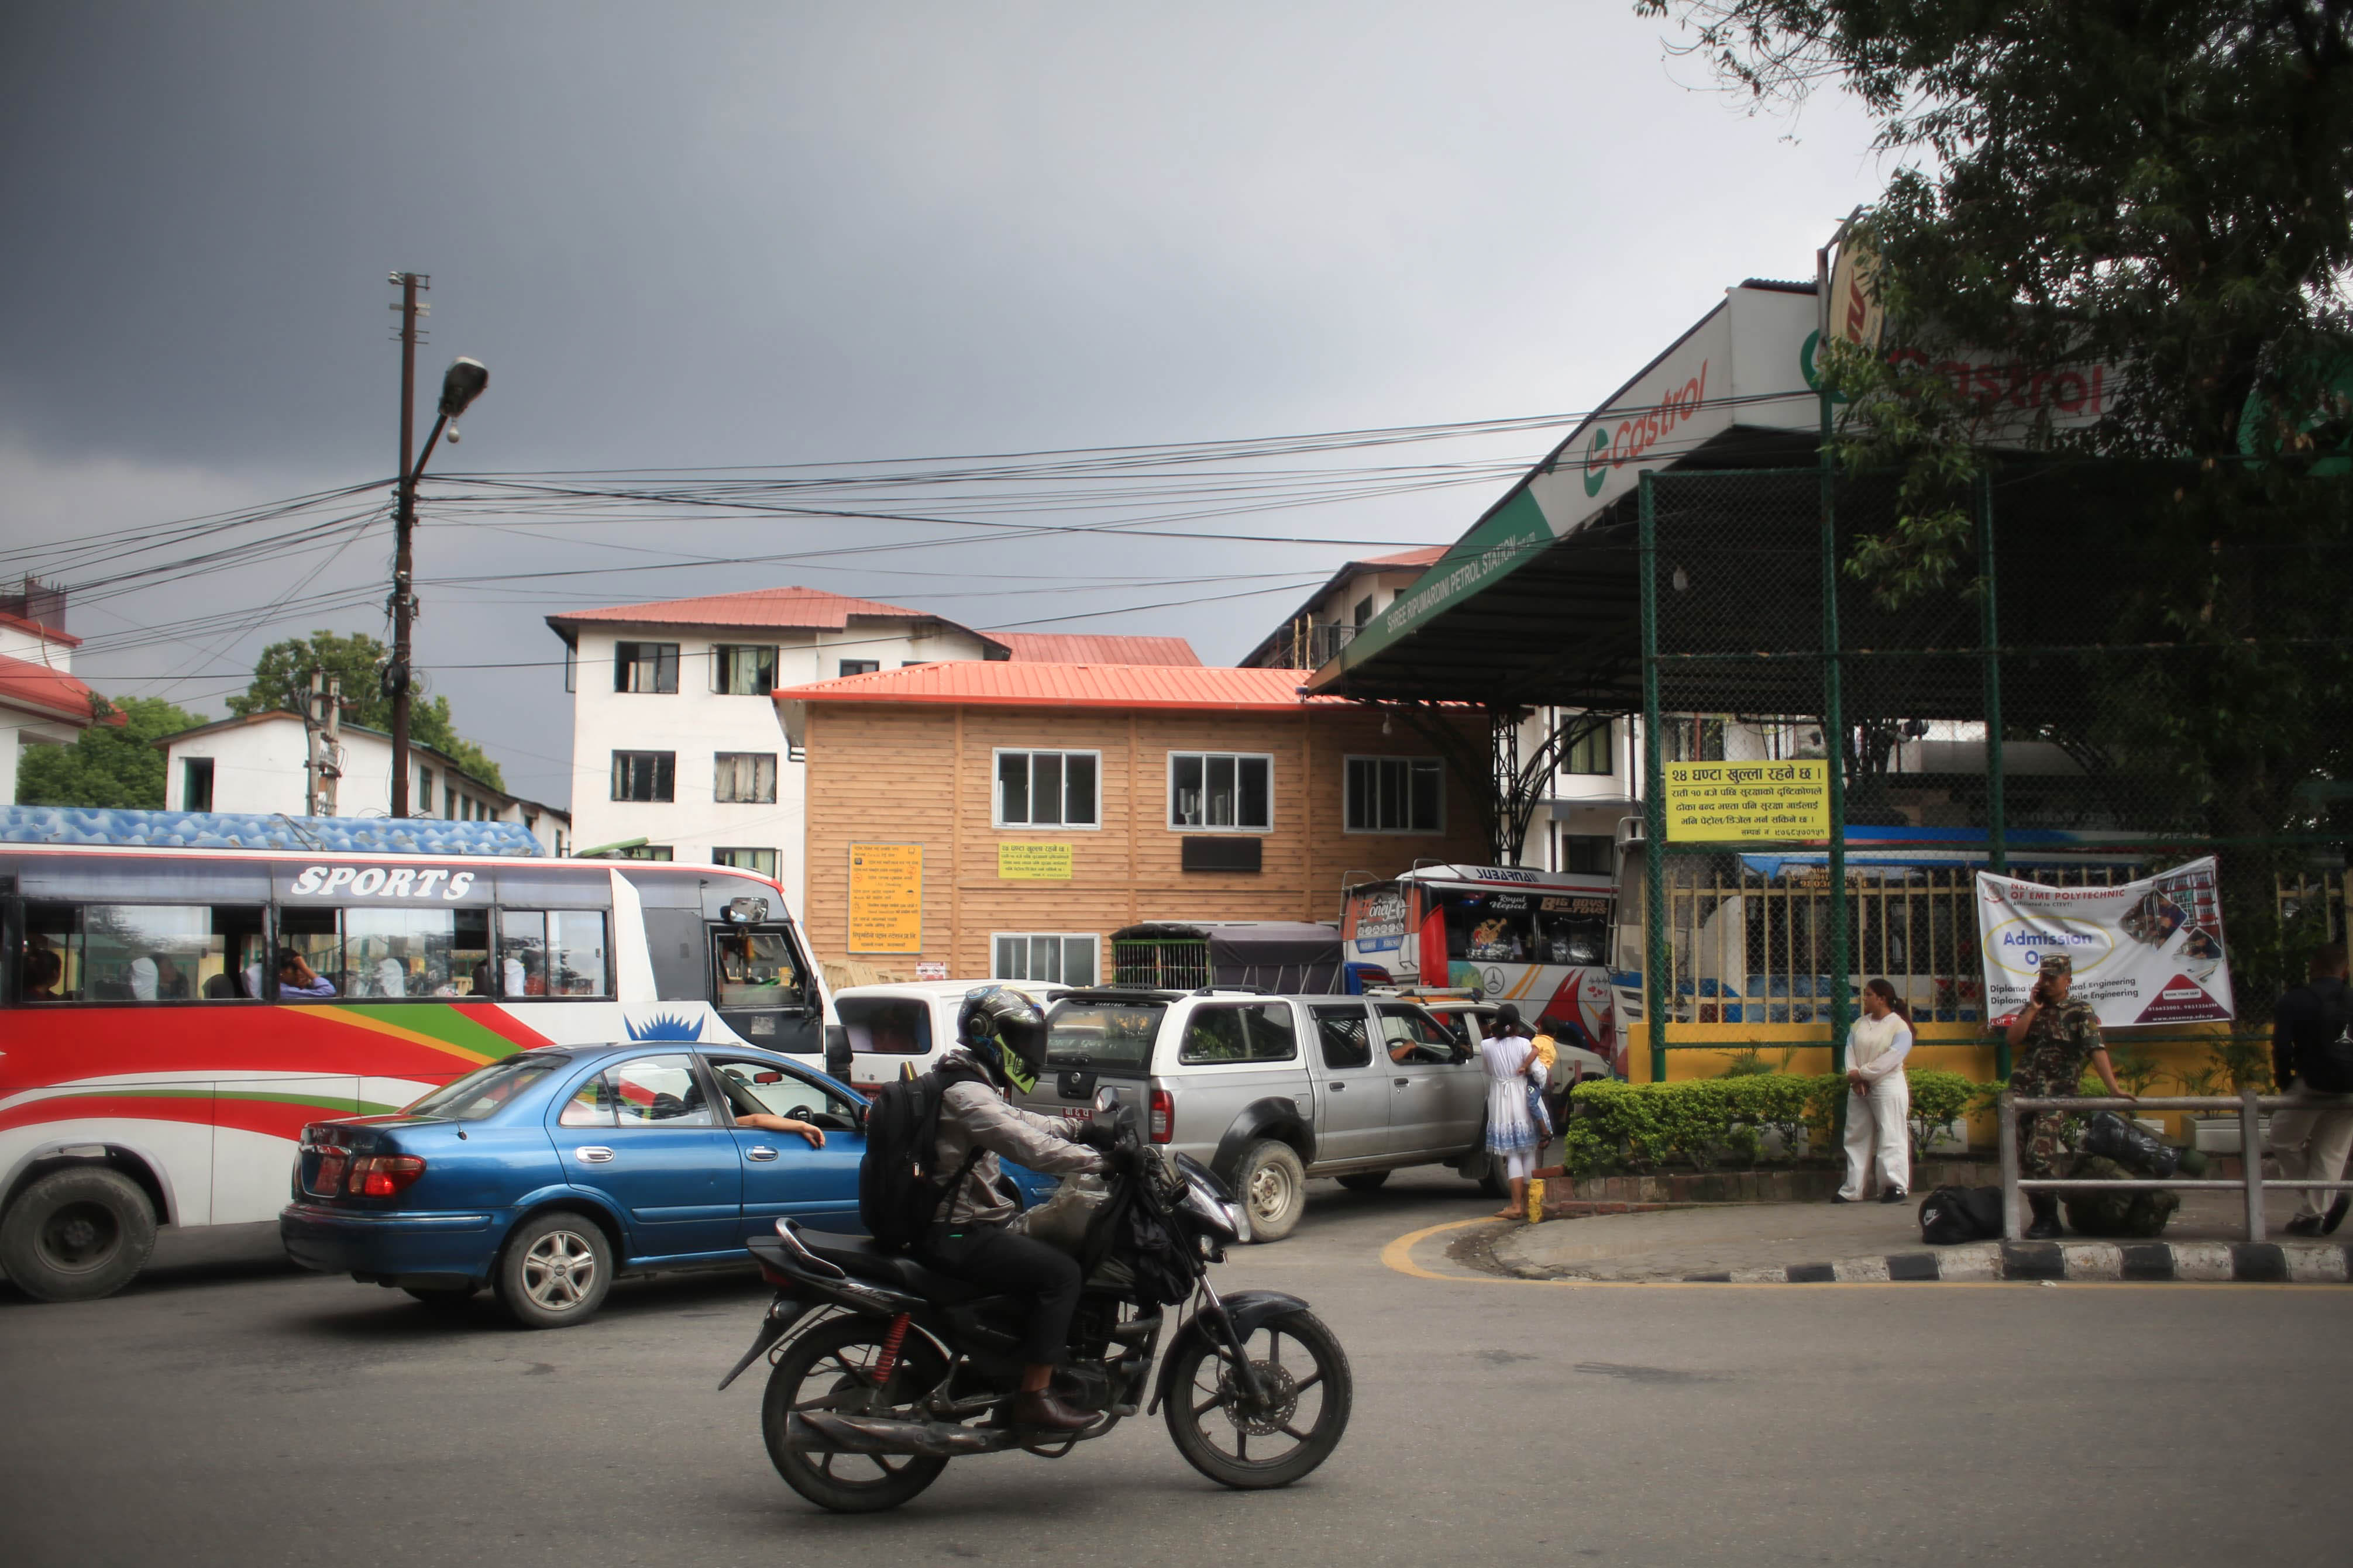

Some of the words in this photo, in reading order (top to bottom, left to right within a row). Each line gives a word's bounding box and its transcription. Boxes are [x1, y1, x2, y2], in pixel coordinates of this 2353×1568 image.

[1613, 357, 1708, 469] Castrol
[1387, 604, 1407, 633] SHREE
[1450, 560, 1481, 594] PETROL
[1482, 535, 1516, 574] STATION
[1672, 769, 1687, 781] २४
[1692, 769, 1722, 781] घण्टा
[1726, 768, 1763, 784] खुल्ला
[1767, 764, 1795, 780] रहने
[1799, 767, 1811, 780] छ
[1671, 788, 1688, 797] राती
[1704, 787, 1717, 796] बजे
[1720, 787, 1736, 796] पछि
[1740, 787, 1774, 797] सुरक्षाको
[1676, 802, 1696, 811] ढोका
[1742, 800, 1757, 809] पनि
[1760, 802, 1783, 811] सुरक्षा
[1771, 814, 1796, 823] सकिने
[1475, 868, 1536, 882] SUBARNA
[291, 866, 475, 901] SPORTS
[1498, 894, 1526, 903] Royal
[2011, 891, 2025, 900] OF
[2055, 890, 2125, 900] POLYTECHNIC
[1489, 901, 1528, 910] Nepal
[2003, 930, 2092, 946] Admission
[1990, 985, 2026, 995] Diploma
[2089, 977, 2136, 989] Engineering
[1991, 997, 2027, 1005] Diploma
[2091, 989, 2139, 1000] Engineering
